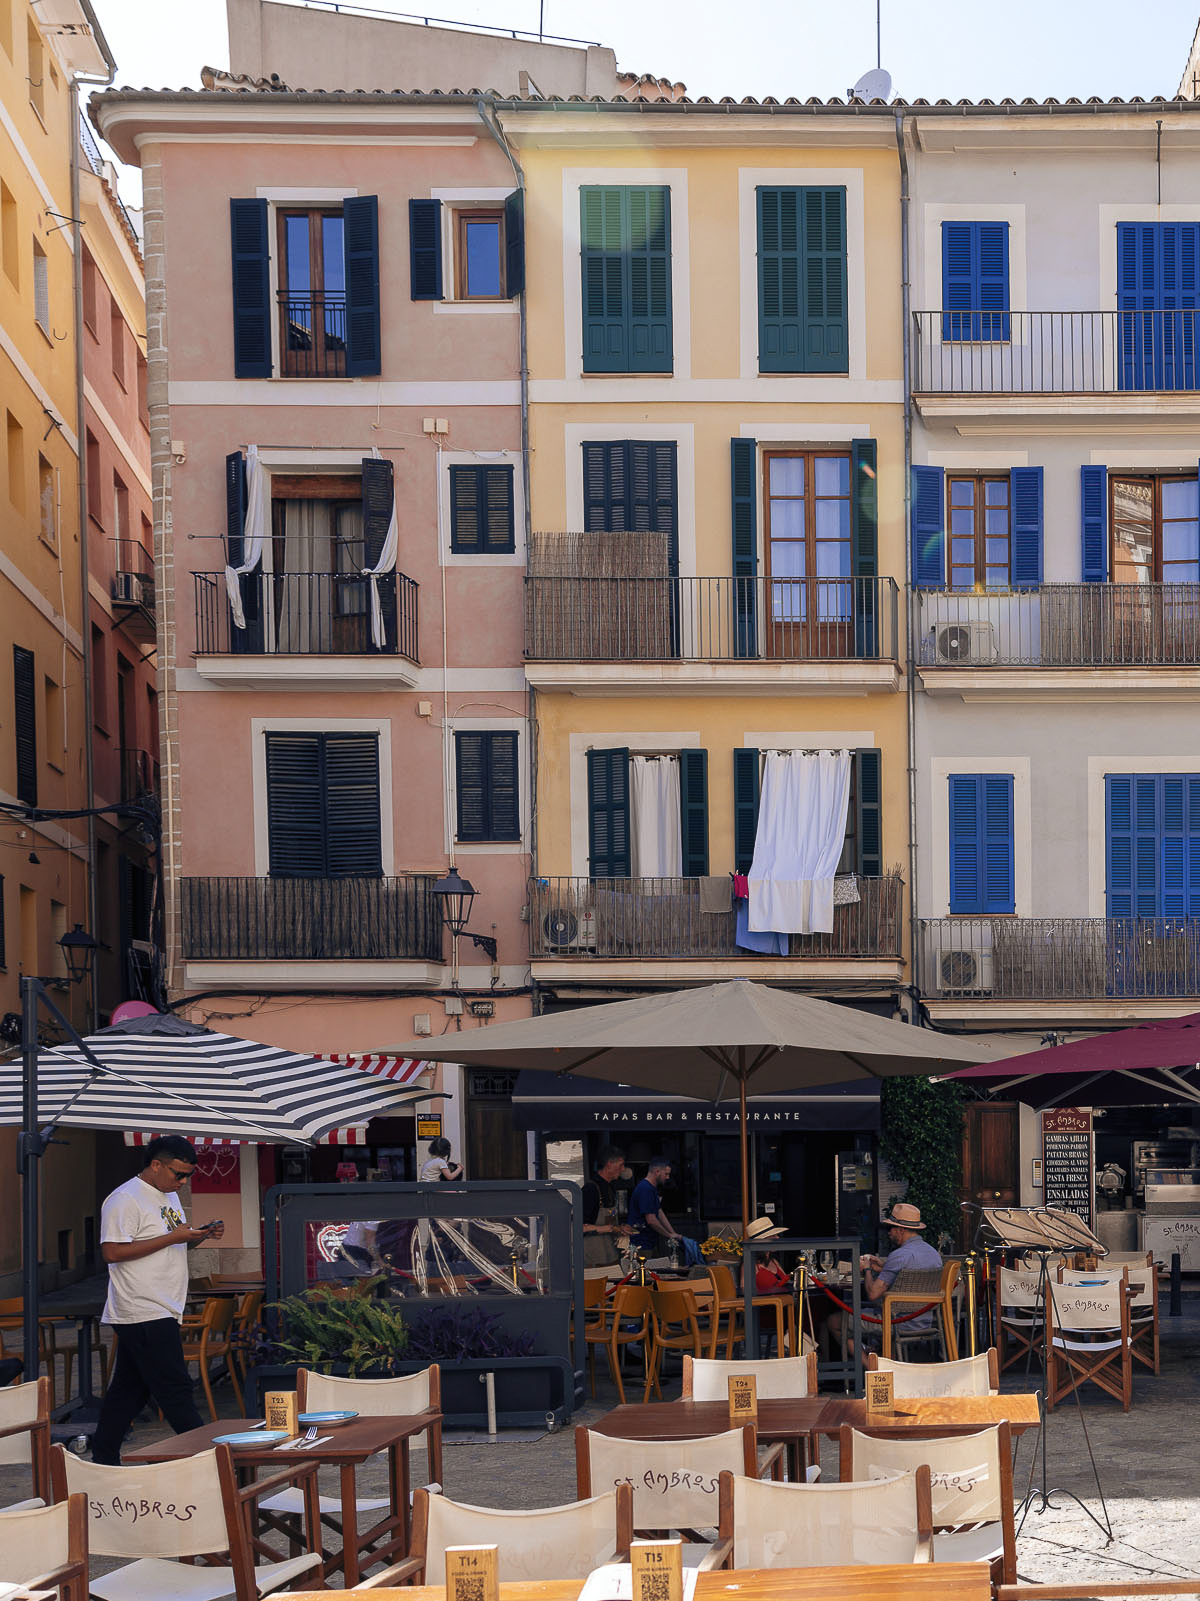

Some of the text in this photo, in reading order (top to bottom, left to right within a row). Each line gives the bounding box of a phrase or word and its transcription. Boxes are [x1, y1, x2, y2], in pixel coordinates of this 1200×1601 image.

[594, 1112, 638, 1121] TAPAS
[646, 1112, 673, 1121] BAR
[681, 1112, 688, 1121] &
[1069, 1135, 1088, 1143] AJILLO
[1046, 1174, 1088, 1182] PASTA FRESCA
[1047, 1189, 1089, 1199] ENSALADAS
[1076, 1206, 1089, 1214] FISH
[271, 1397, 285, 1405] T23
[644, 1551, 664, 1563] T15
[458, 1556, 478, 1567] T14
